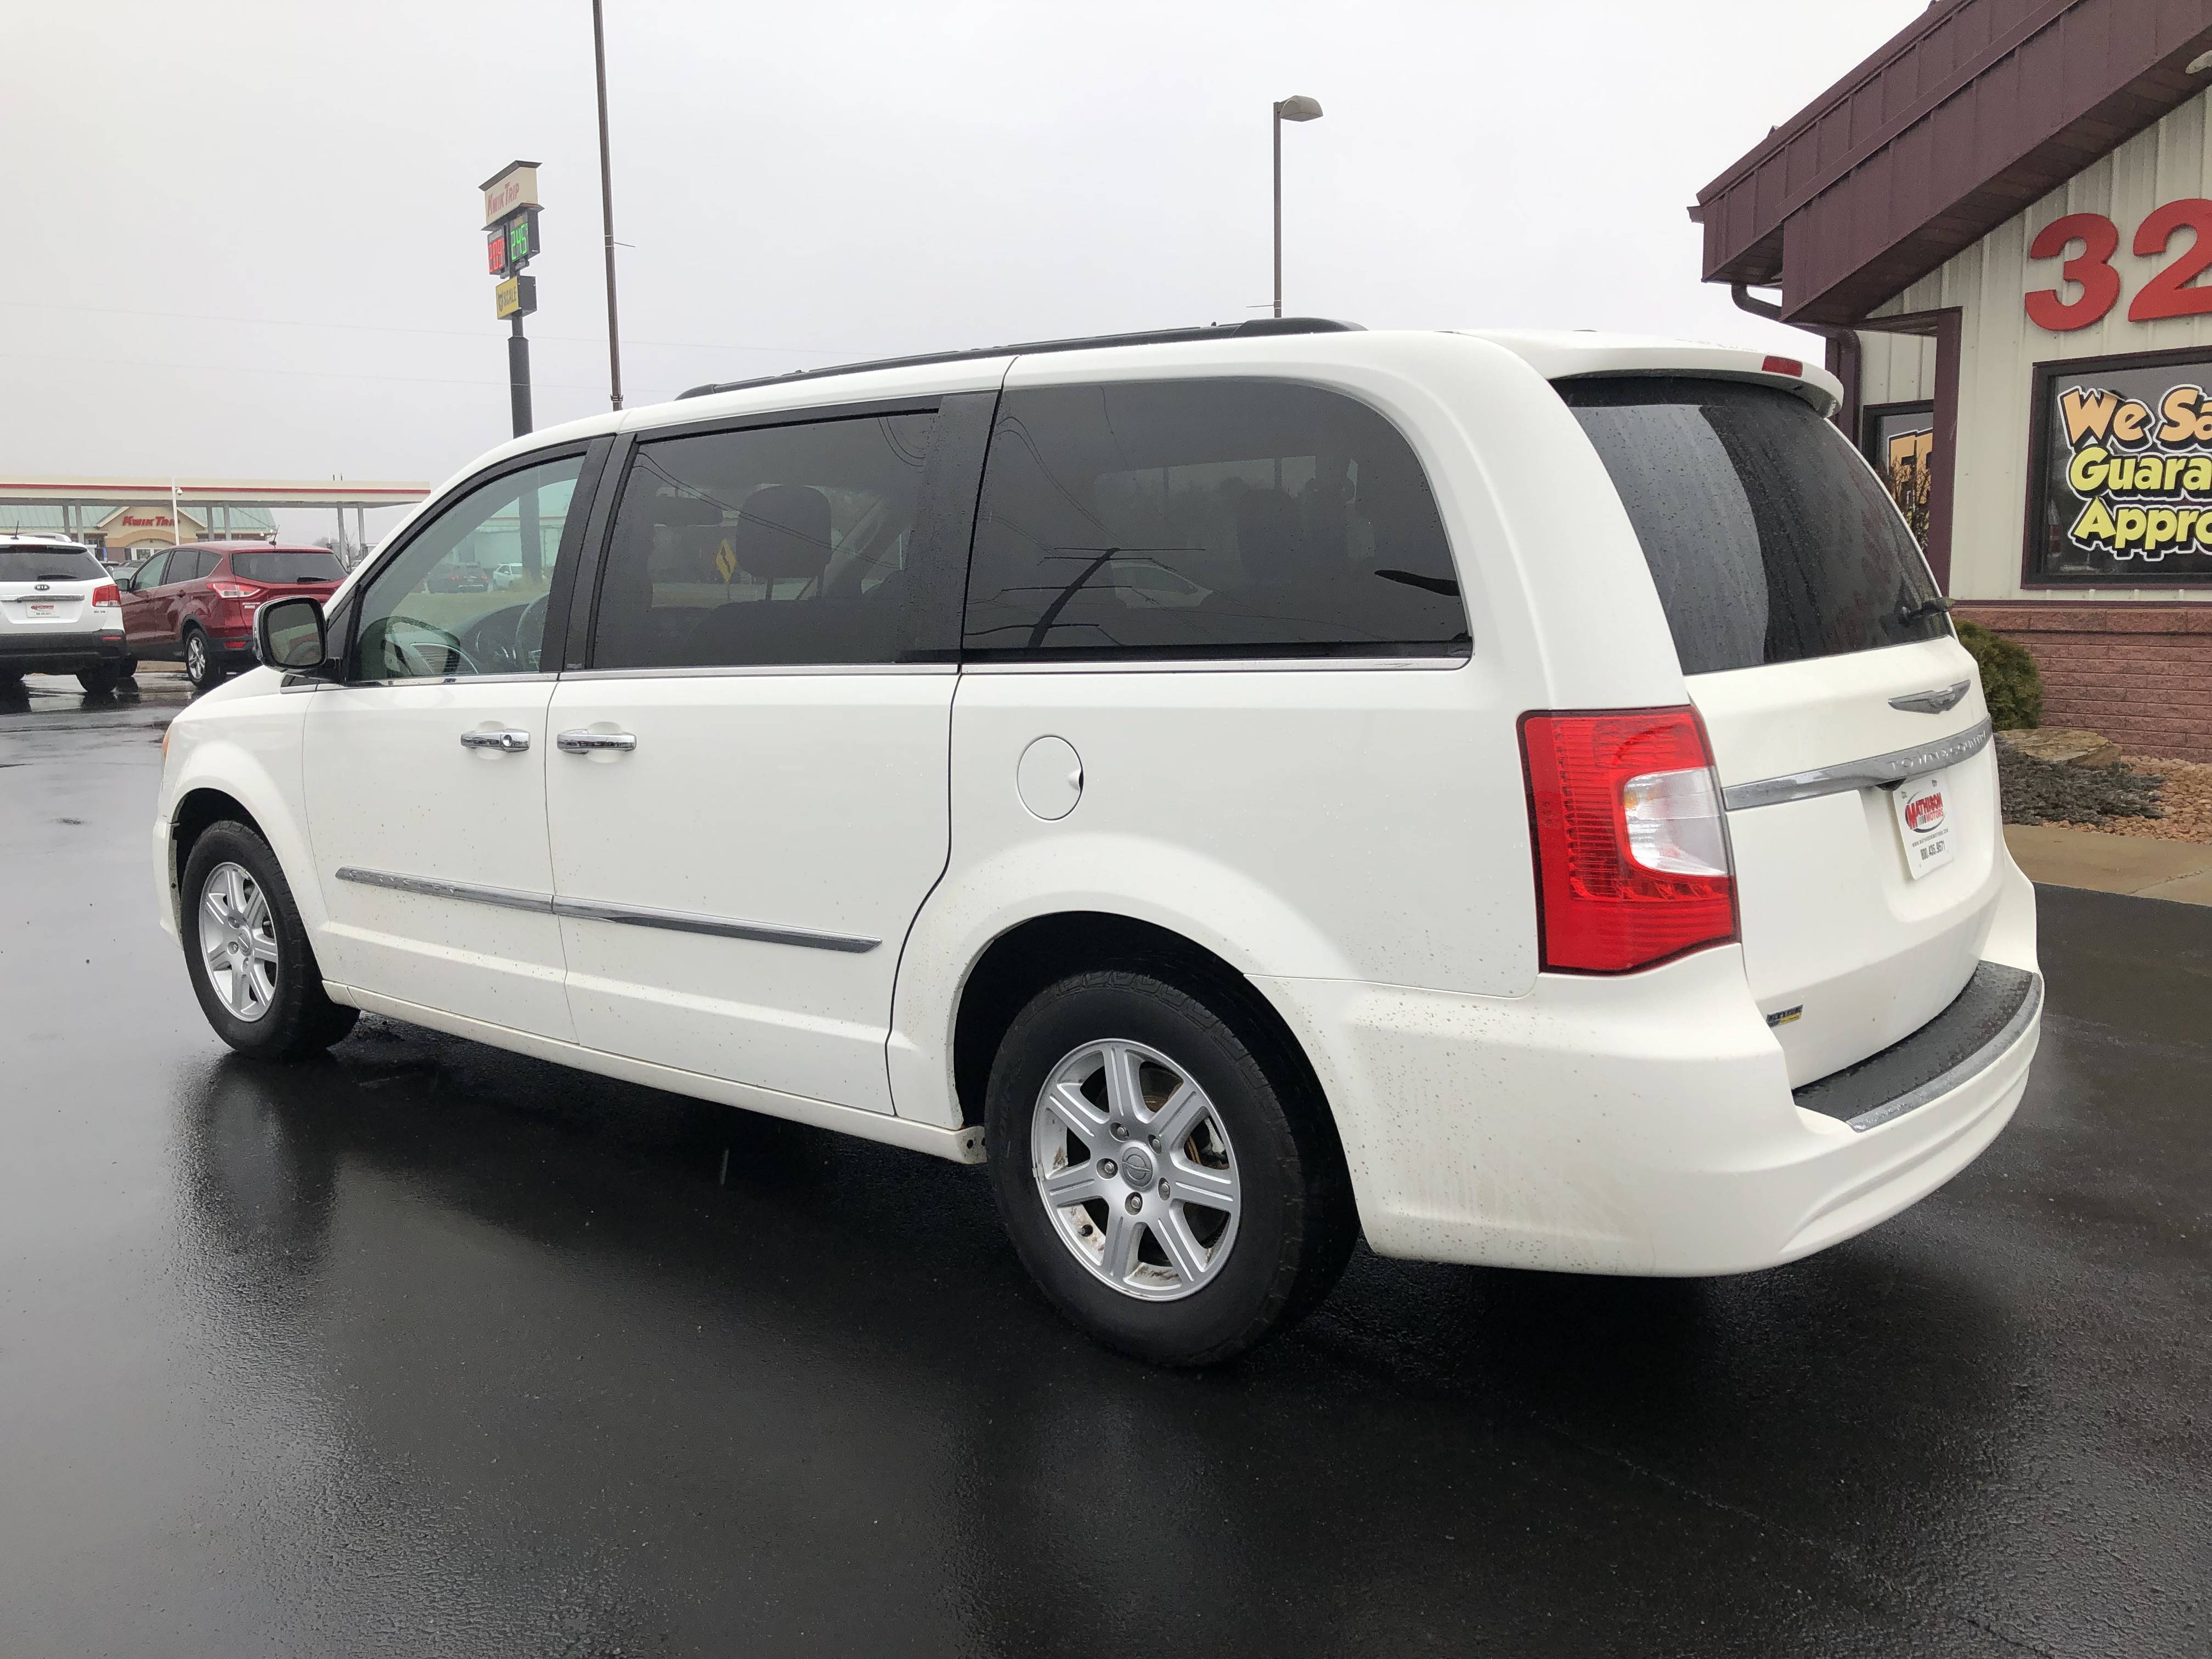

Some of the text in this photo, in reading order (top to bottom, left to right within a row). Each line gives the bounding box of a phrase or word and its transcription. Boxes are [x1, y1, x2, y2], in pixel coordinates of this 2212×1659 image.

[2024, 198, 2212, 331] 32
[2062, 387, 2212, 445] We Sa
[2069, 445, 2212, 492] Guara
[1926, 808, 1944, 823] MOTORS
